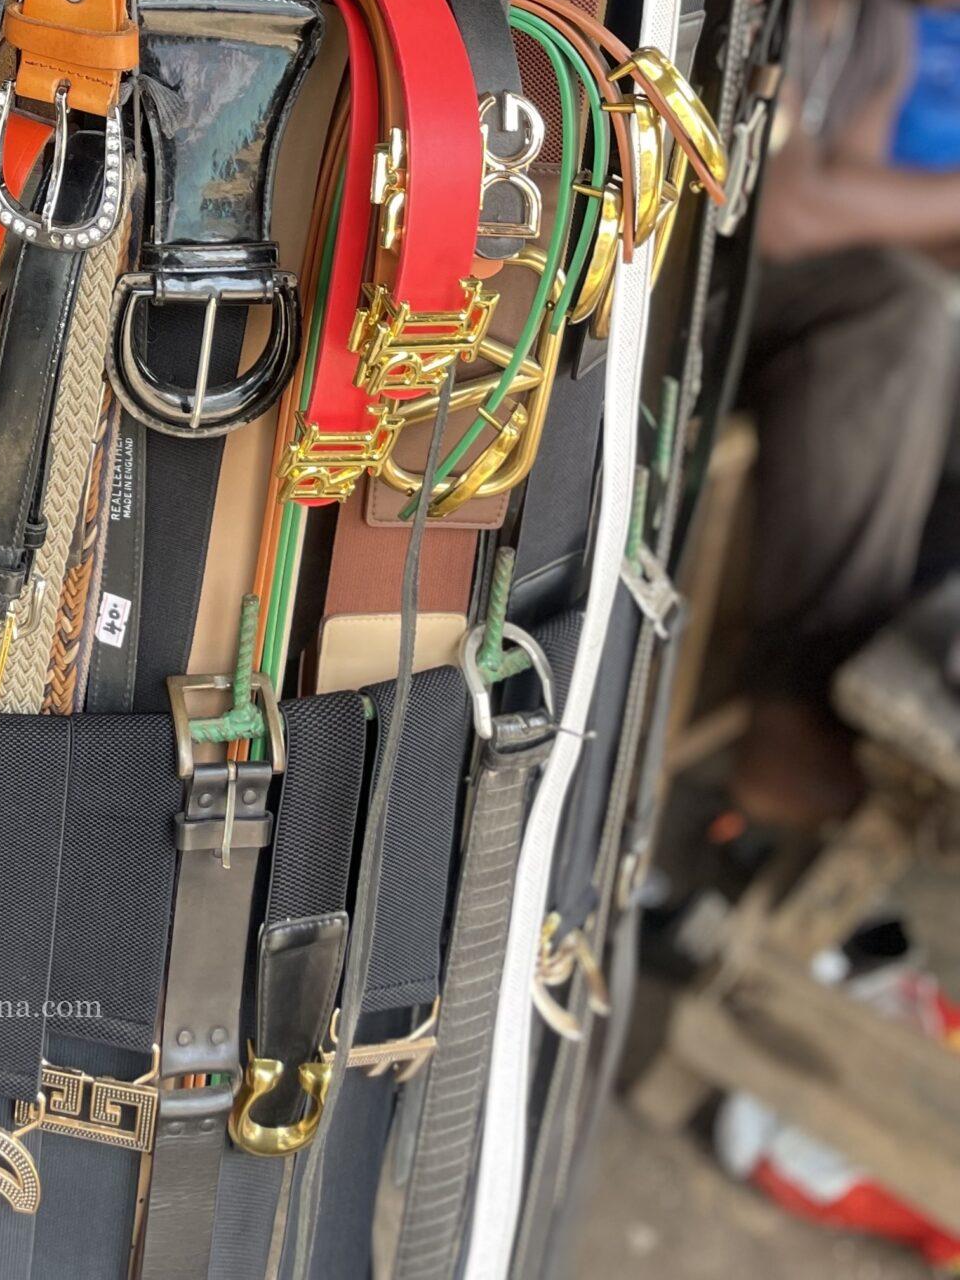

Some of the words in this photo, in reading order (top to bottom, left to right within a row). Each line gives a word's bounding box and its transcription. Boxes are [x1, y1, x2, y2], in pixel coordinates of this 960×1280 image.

[124, 437, 134, 479] ENGLAND
[110, 487, 122, 521] REAL
[123, 493, 132, 518] MADE
[103, 602, 123, 635] 40.
